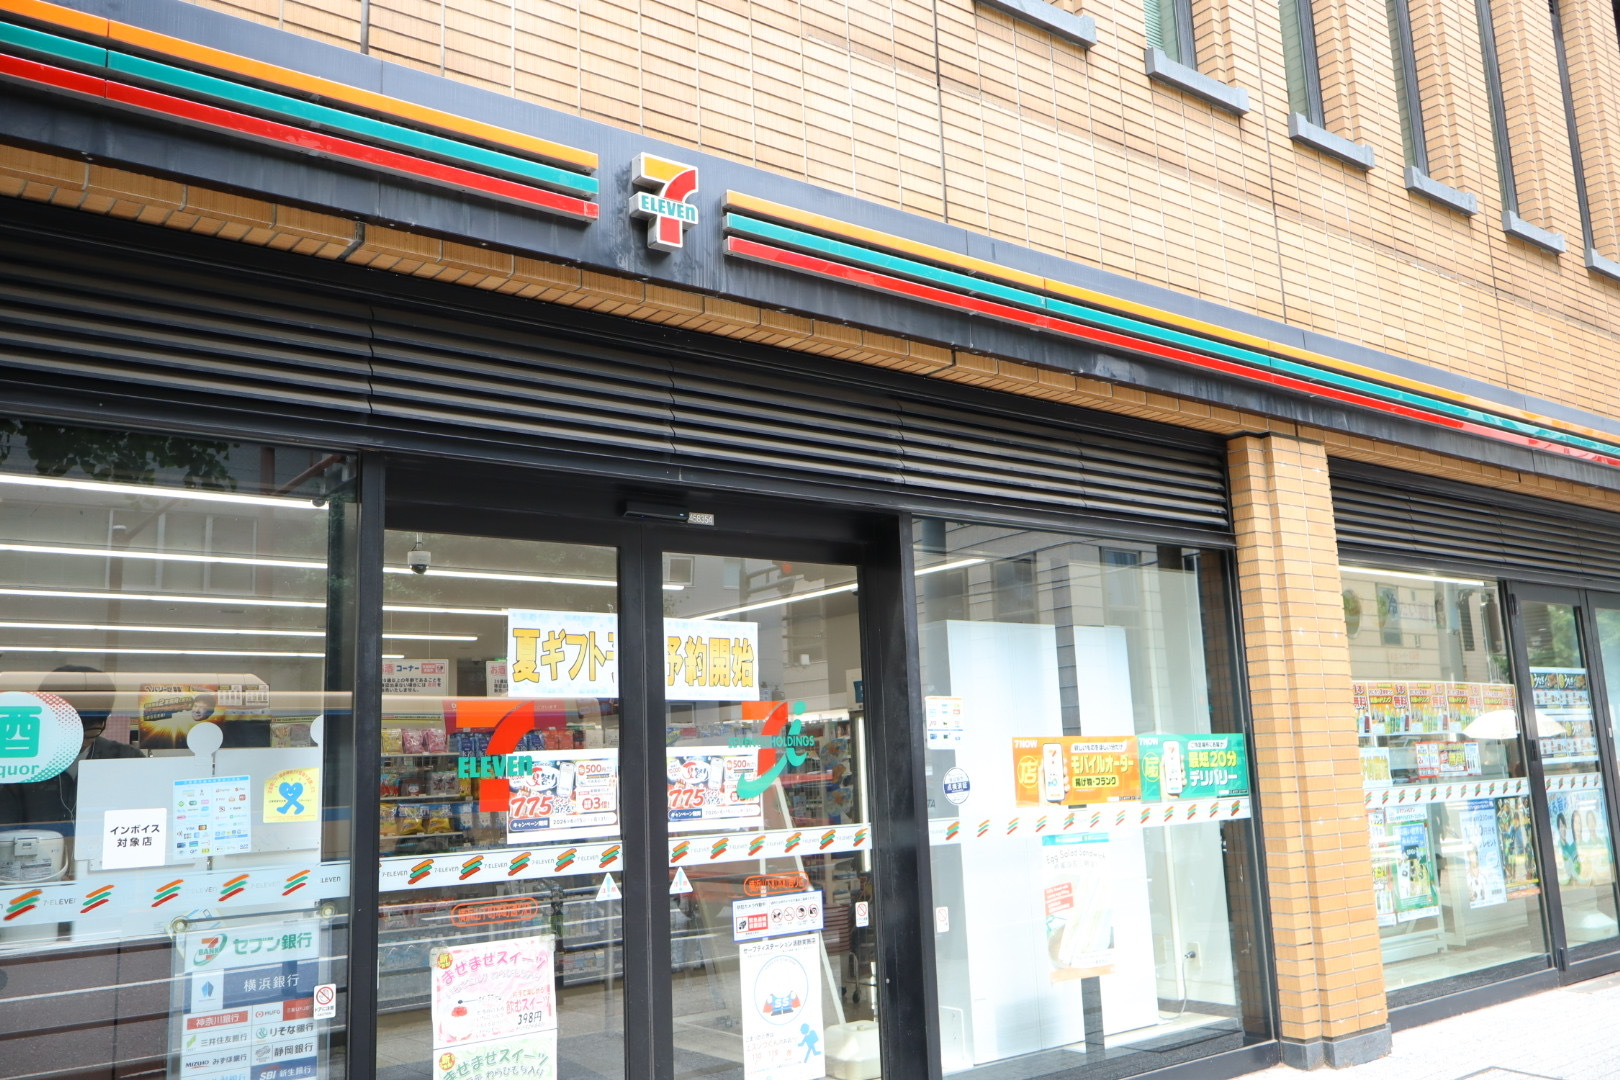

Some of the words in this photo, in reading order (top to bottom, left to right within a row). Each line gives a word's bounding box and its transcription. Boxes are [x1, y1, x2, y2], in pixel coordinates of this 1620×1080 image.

[396, 664, 420, 672] コーナー
[769, 735, 815, 747] HOLDINGS
[1071, 753, 1134, 775] モバイルオーダー
[1188, 749, 1238, 769] 最短20分
[1189, 769, 1239, 787] デリバリー
[109, 823, 161, 837] インボイス
[116, 836, 153, 849] 対象店
[233, 931, 313, 955] セブン銀行
[243, 973, 300, 992] 横浜銀行
[195, 1013, 240, 1028] 神奈川銀行
[517, 1010, 543, 1025] 398円
[270, 1022, 315, 1037] りそな銀行
[200, 1033, 248, 1047] 三井住友銀行
[274, 1043, 314, 1057] 静岡銀行
[212, 1054, 248, 1066] みずほ銀行
[259, 1071, 277, 1080] SBI
[279, 1065, 312, 1077] 新生銀行
